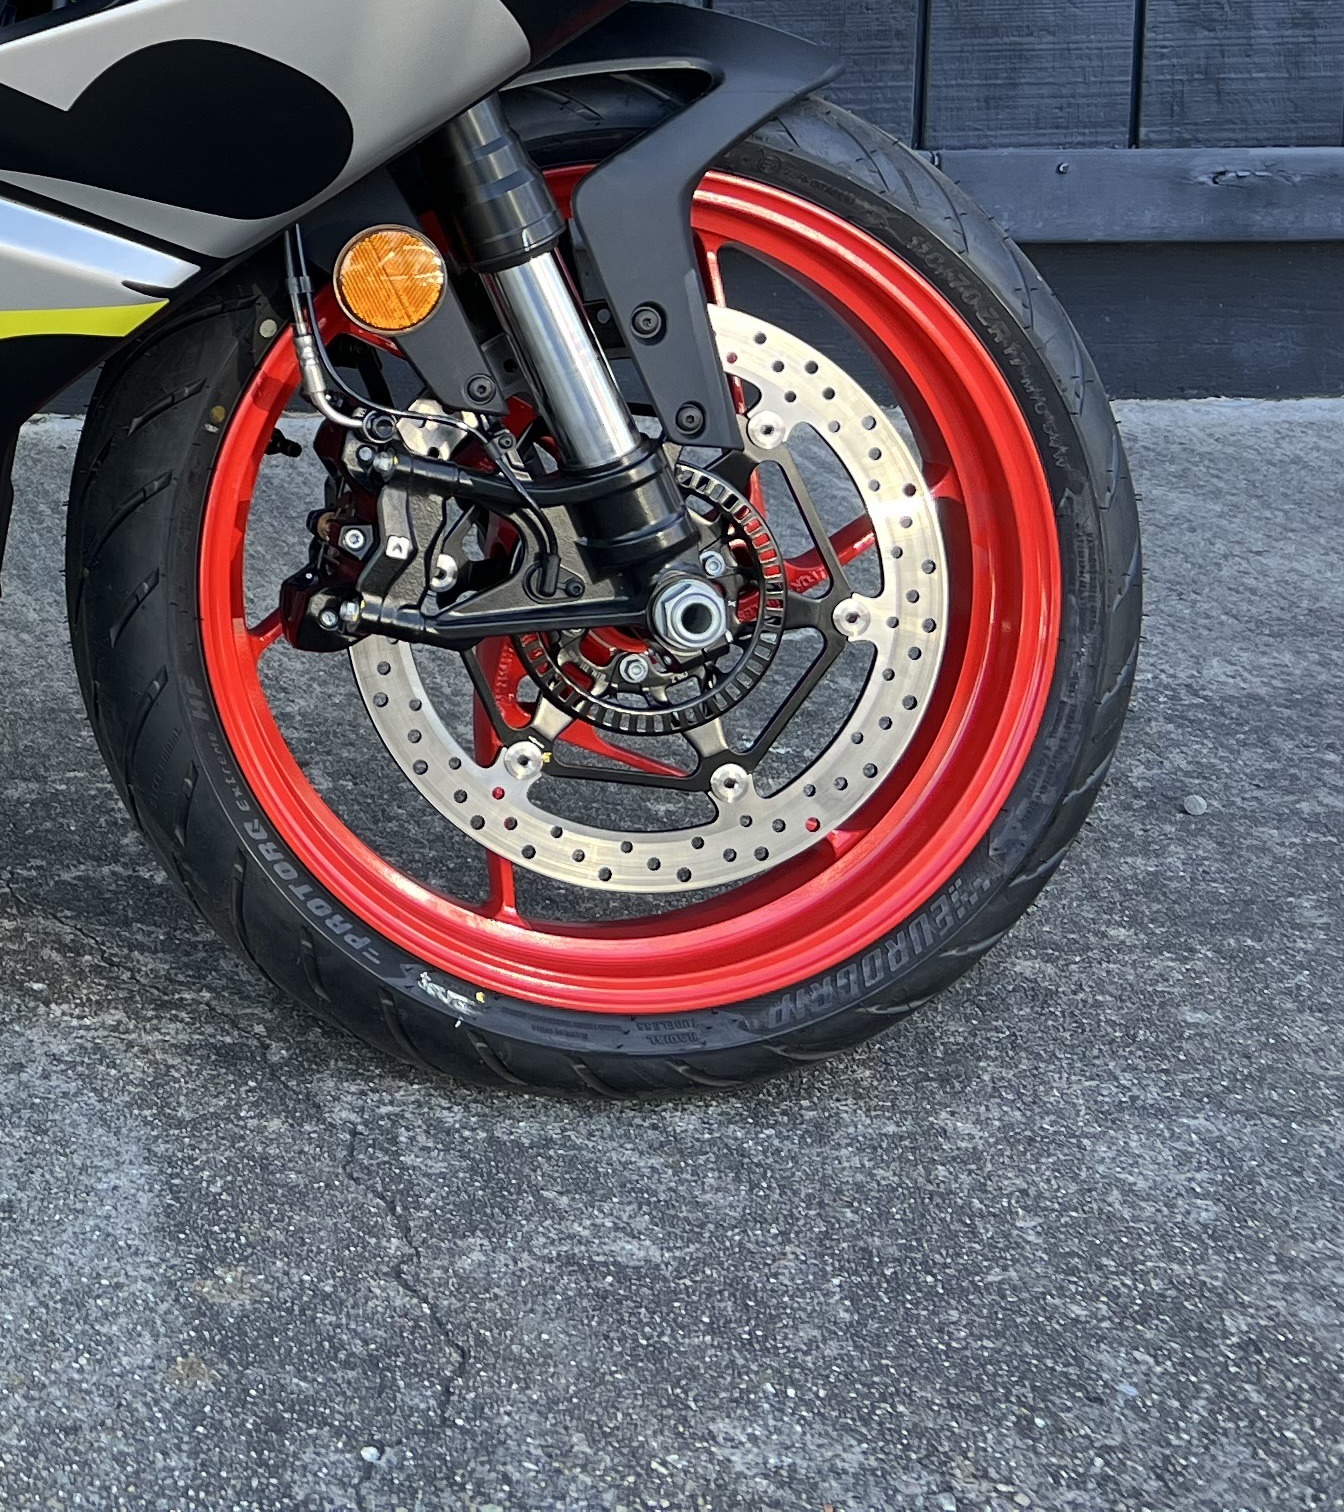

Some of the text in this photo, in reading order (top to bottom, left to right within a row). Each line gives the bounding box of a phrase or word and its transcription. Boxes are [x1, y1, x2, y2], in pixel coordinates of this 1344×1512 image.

[203, 728, 252, 814] Extreme
[238, 814, 374, 954] PROTORQ
[766, 895, 961, 1028] EUROGRIP
[635, 1017, 696, 1033] TUBELESS
[646, 1030, 698, 1046] RADIAL
